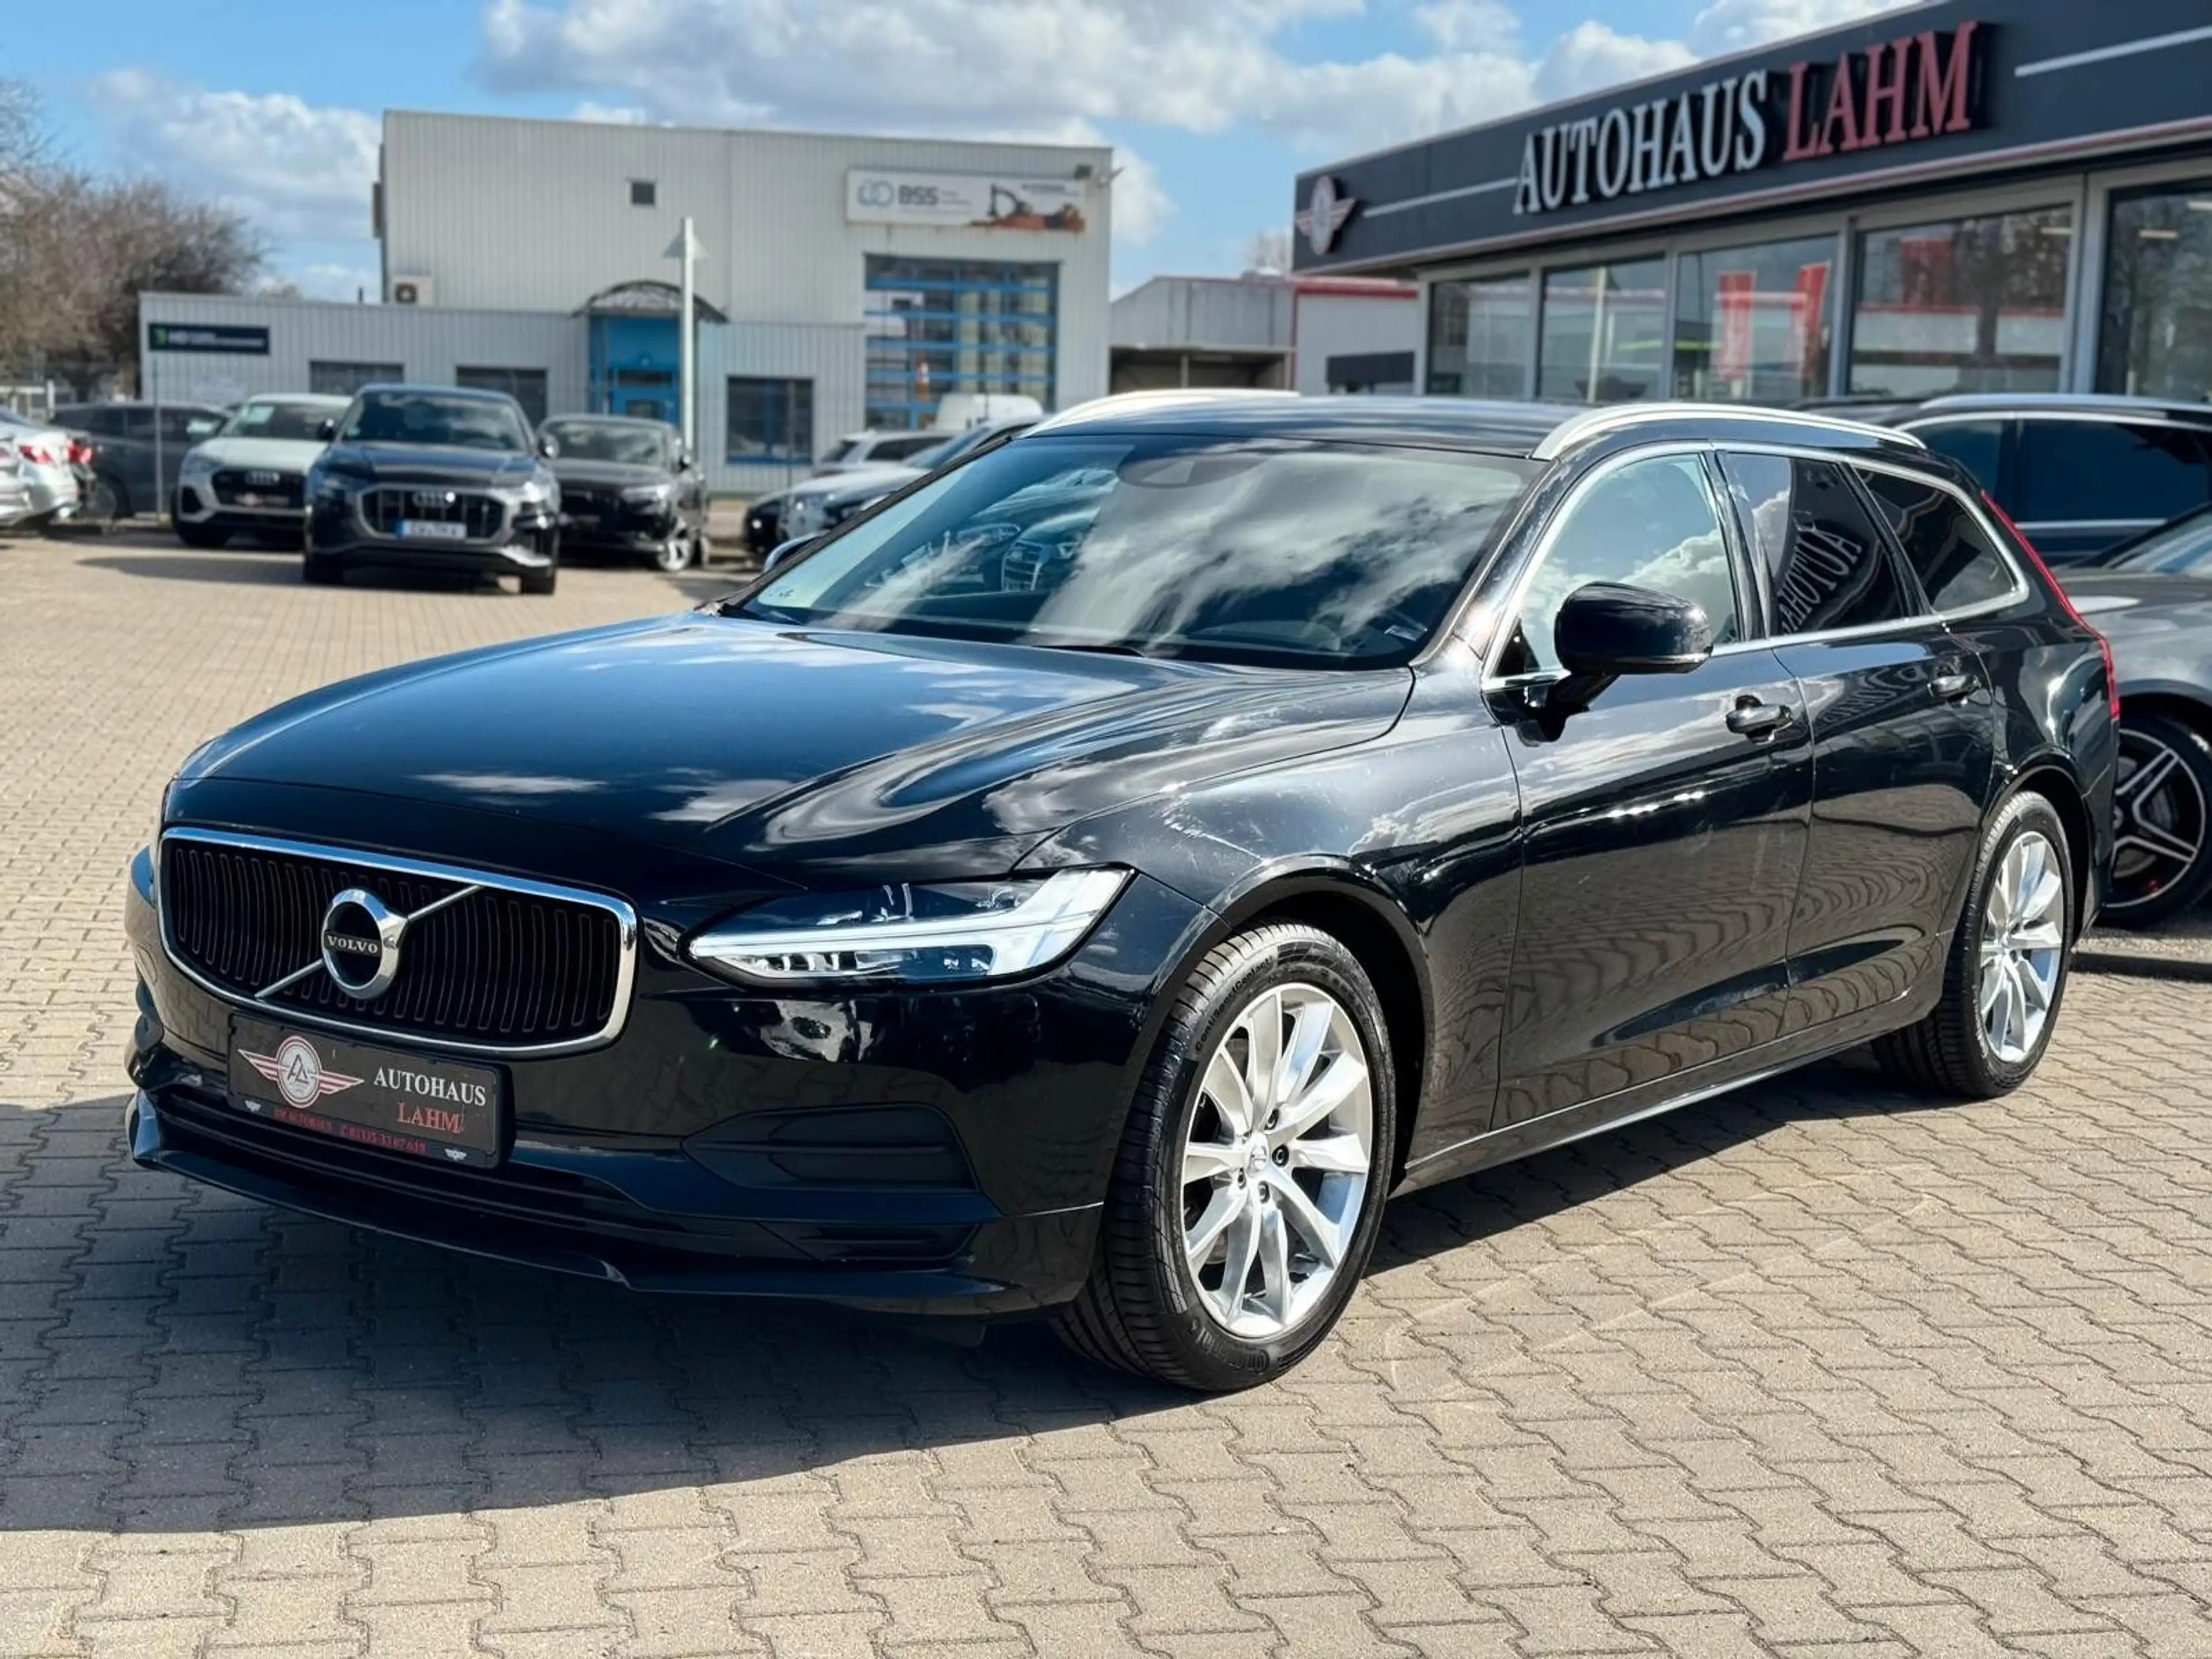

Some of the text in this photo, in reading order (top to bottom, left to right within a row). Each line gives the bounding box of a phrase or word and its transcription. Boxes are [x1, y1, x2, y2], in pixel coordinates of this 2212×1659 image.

[1514, 22, 1978, 214] AUTOHAUS LAHM
[327, 935, 378, 953] VOLVO
[374, 1067, 486, 1105] AUTOHAUS
[396, 1101, 463, 1134] LAHM
